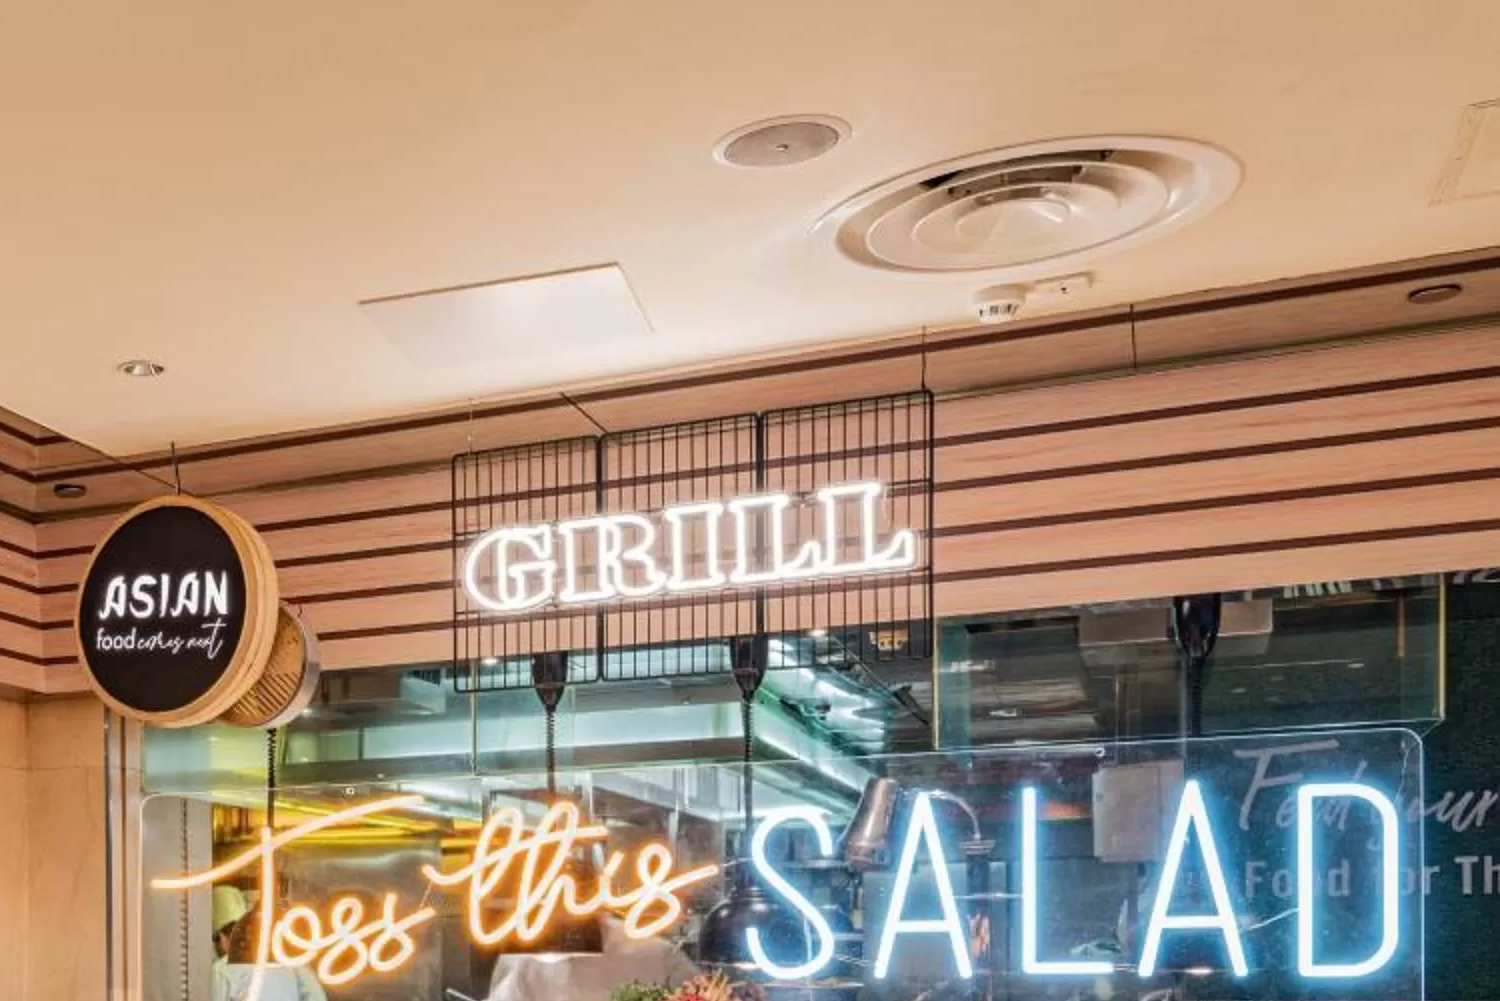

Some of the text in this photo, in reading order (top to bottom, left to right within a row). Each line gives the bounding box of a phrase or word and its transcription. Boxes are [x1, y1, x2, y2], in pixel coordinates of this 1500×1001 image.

[465, 482, 916, 612] GRILL
[98, 570, 228, 619] ASIAN
[97, 627, 136, 650] food
[422, 801, 719, 945] this
[746, 778, 1400, 980] SALAD
[1244, 858, 1351, 897] Fod
[1373, 858, 1441, 896] or
